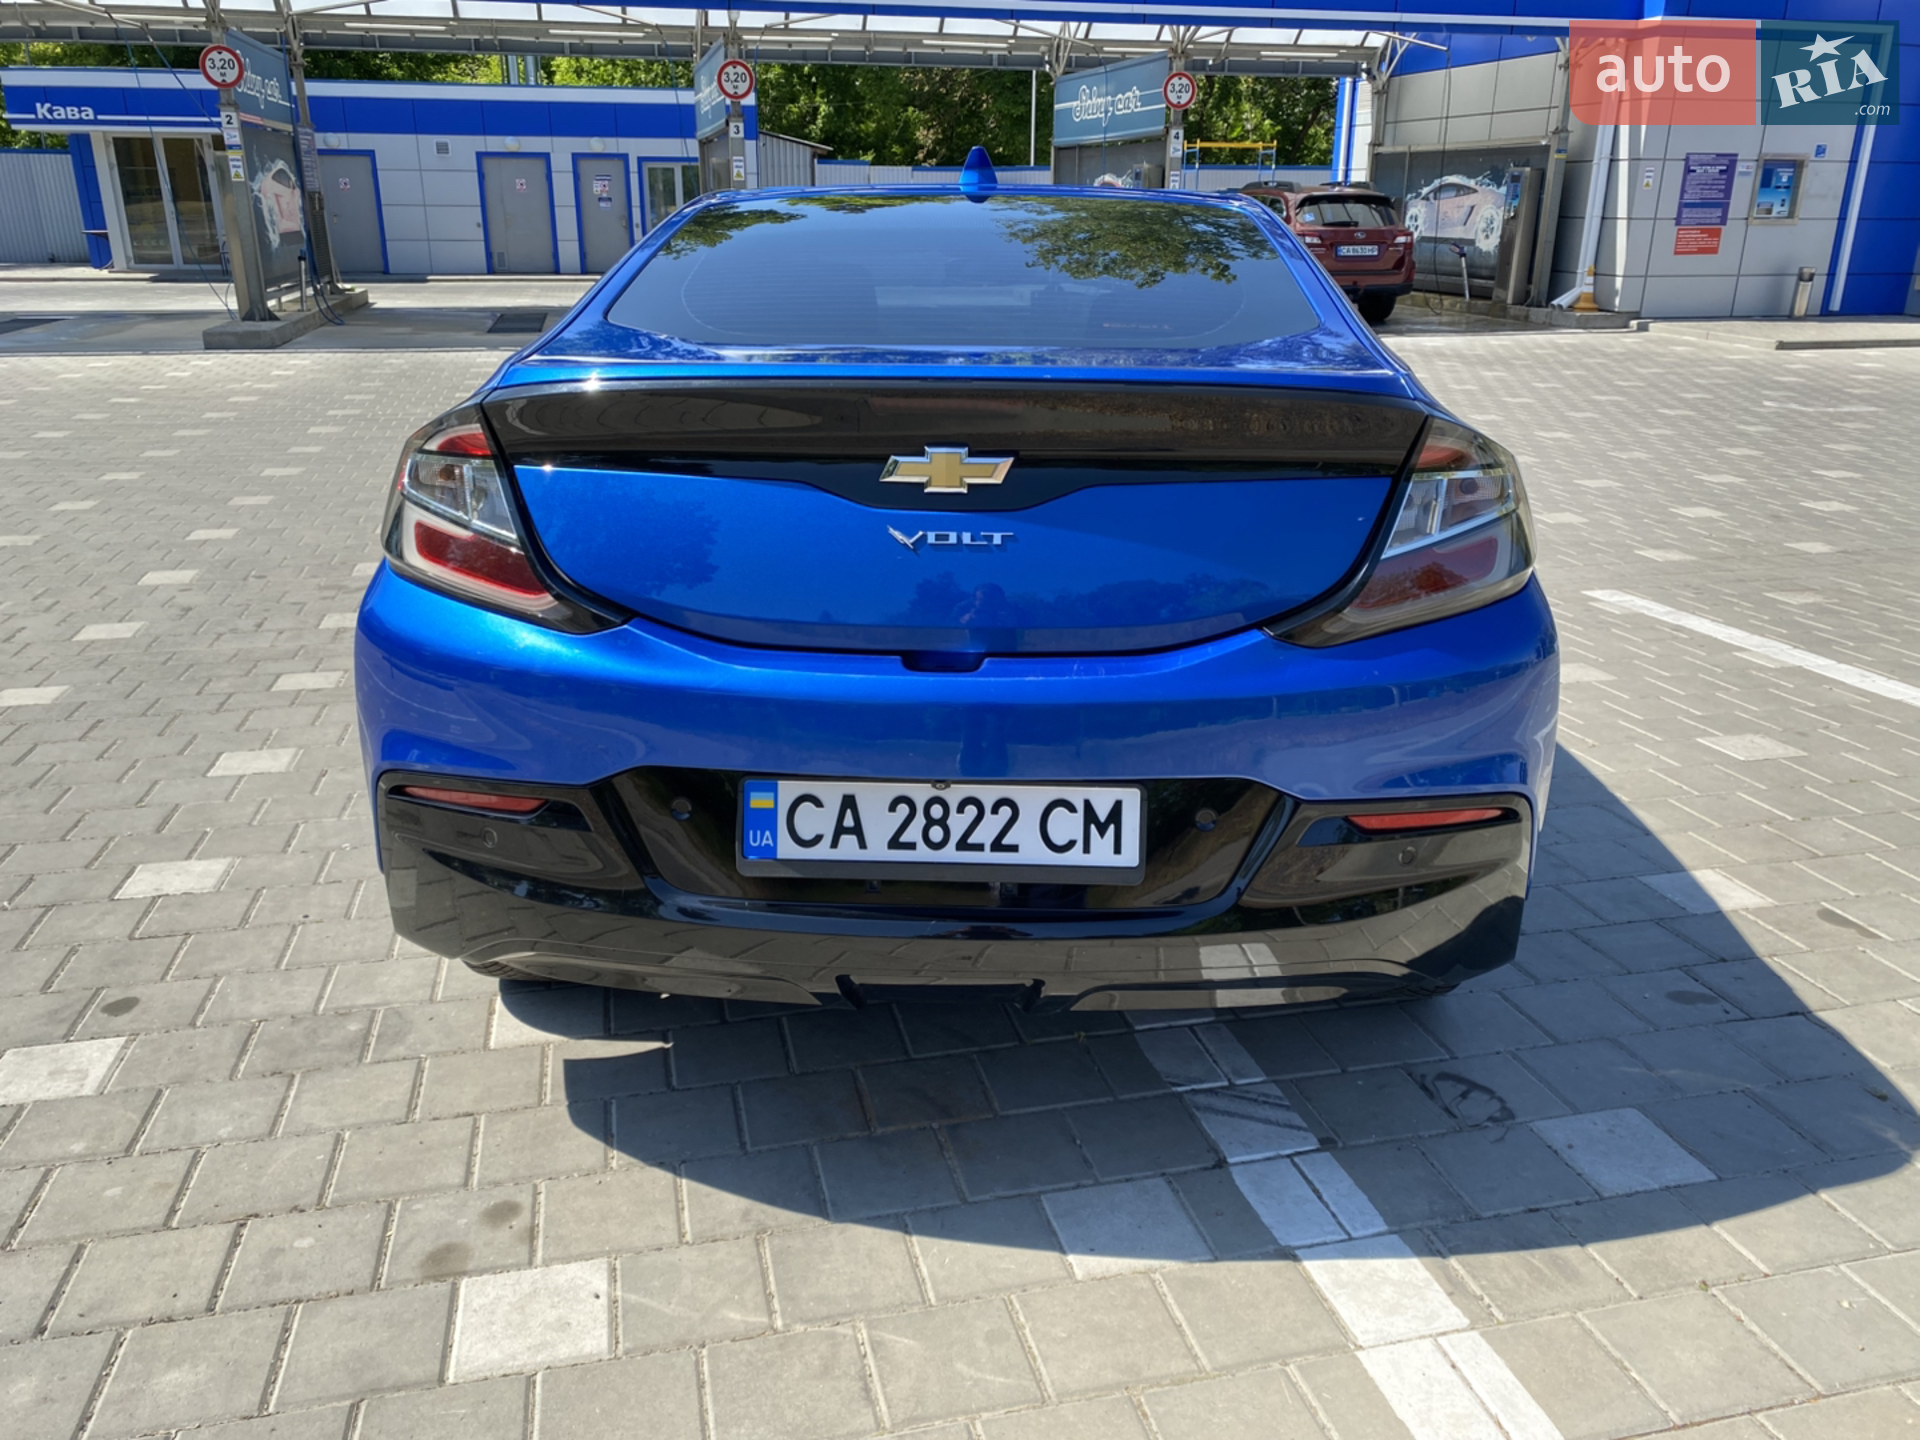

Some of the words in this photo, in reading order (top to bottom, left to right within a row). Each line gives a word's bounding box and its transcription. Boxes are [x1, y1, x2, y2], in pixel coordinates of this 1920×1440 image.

[208, 58, 236, 71] 3,20
[723, 72, 748, 85] 3,20
[1169, 83, 1190, 95] 3,20
[35, 102, 95, 120] Кава
[1072, 85, 1113, 127] Shiny
[1114, 86, 1142, 115] car
[225, 114, 233, 125] 2
[733, 124, 740, 135] 3
[1173, 131, 1180, 141] 4
[887, 525, 1014, 549] VOLT
[785, 793, 868, 850] CA
[886, 795, 1020, 853] 2822
[1039, 797, 1123, 855] CM
[749, 830, 774, 847] UA
